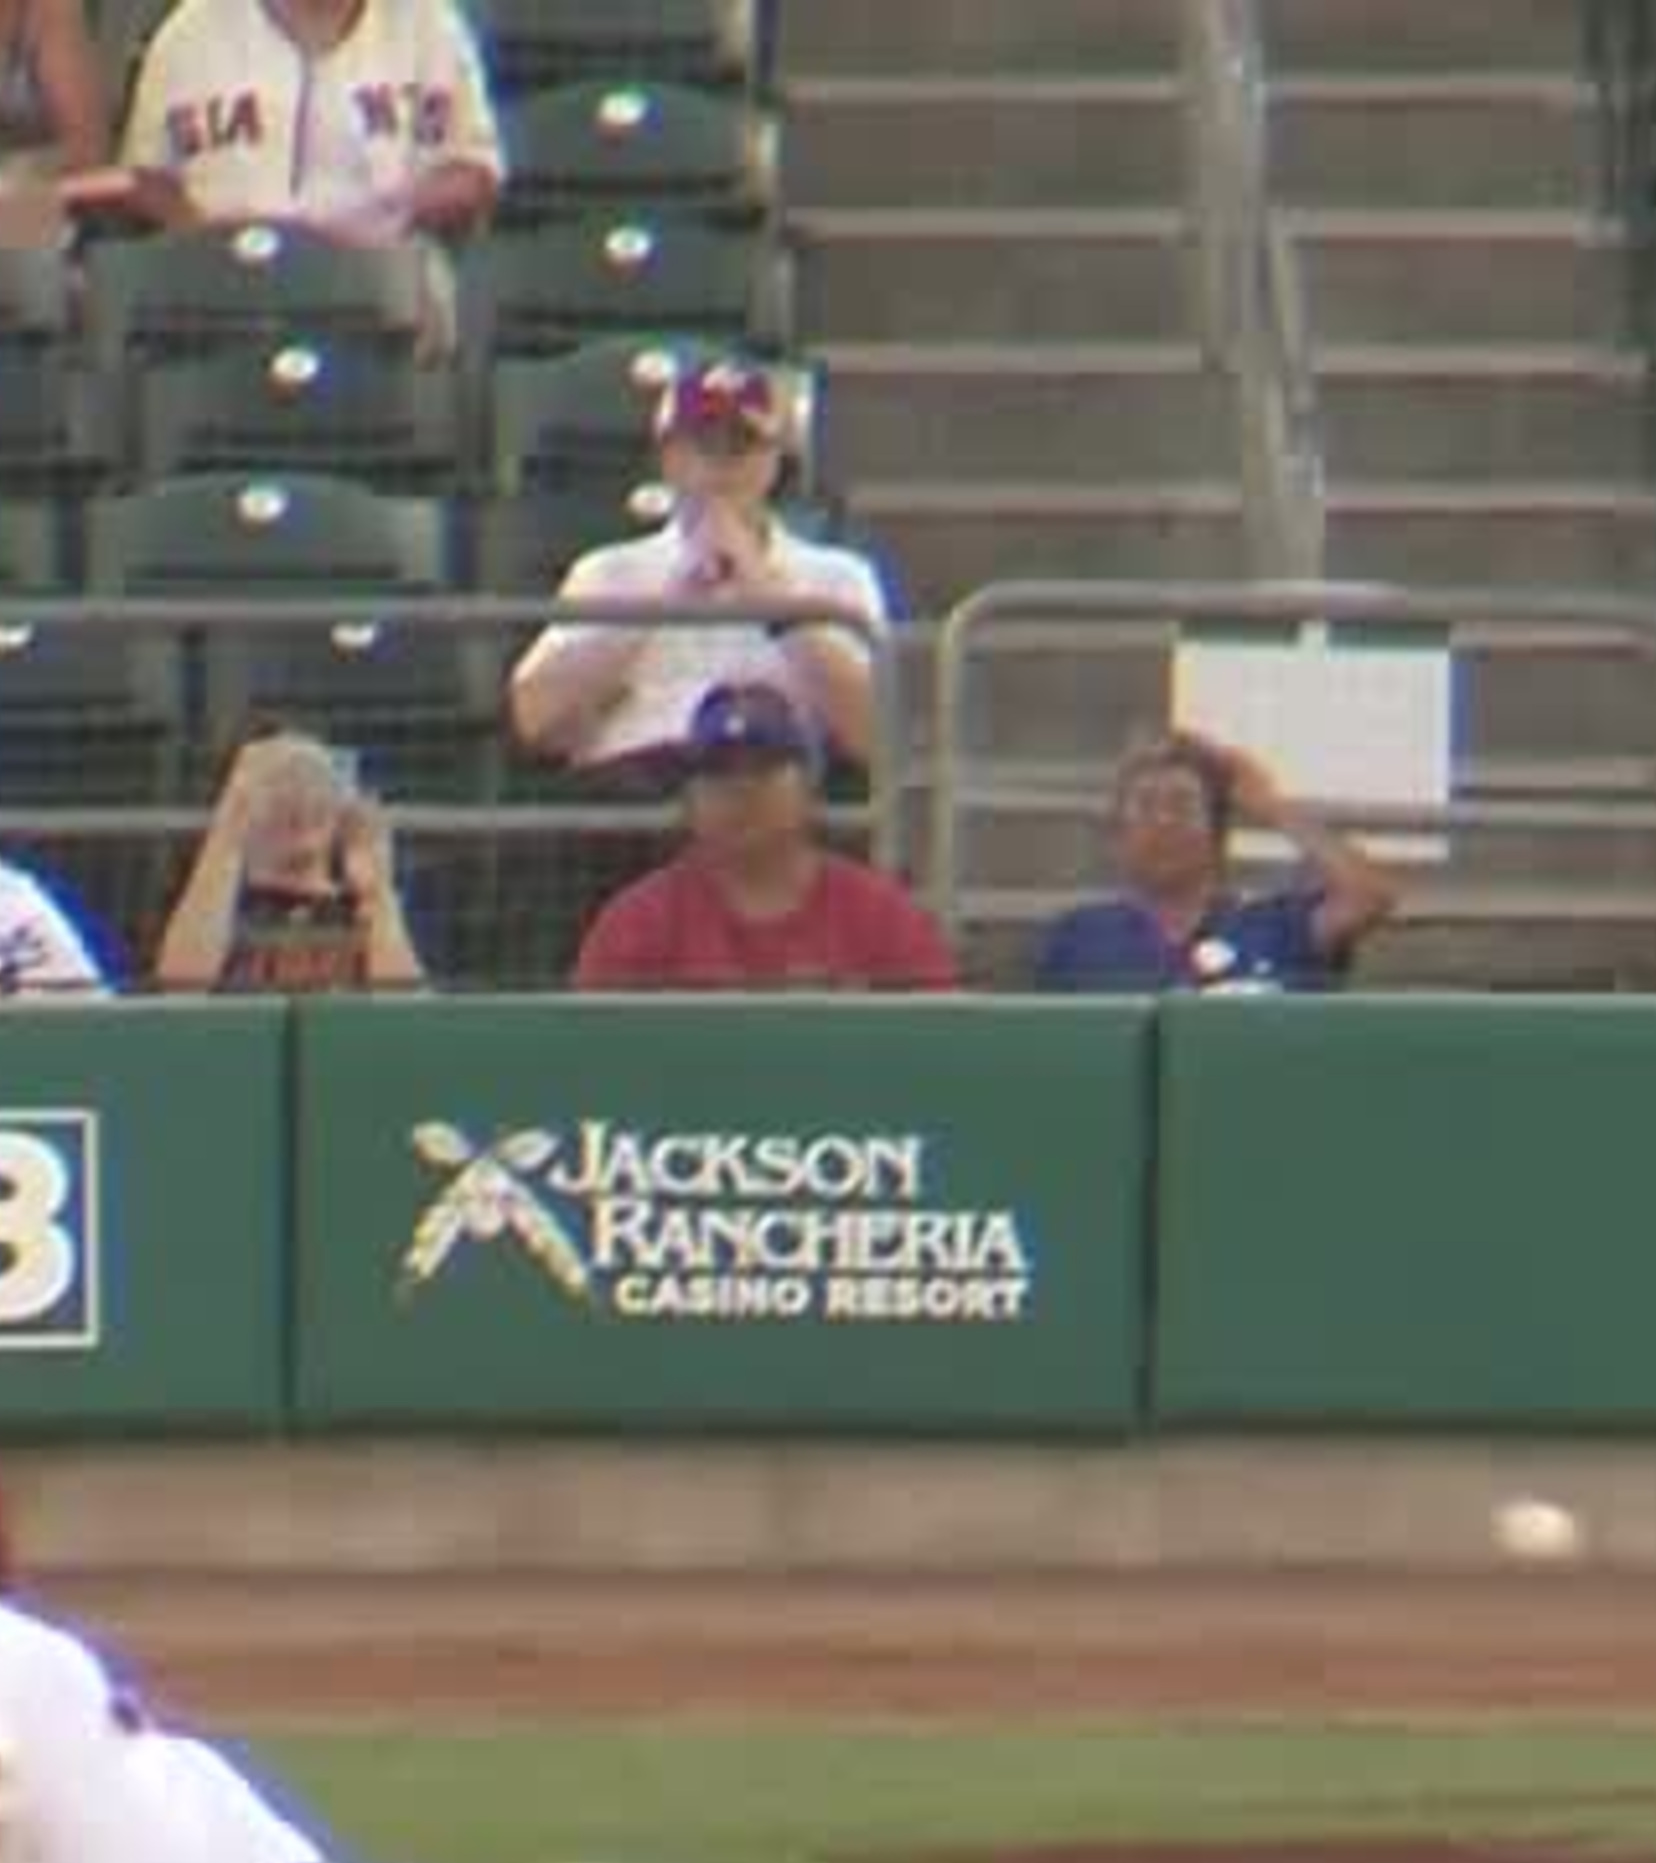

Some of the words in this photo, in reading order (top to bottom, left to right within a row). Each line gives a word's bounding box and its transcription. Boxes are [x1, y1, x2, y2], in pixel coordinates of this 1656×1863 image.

[549, 1120, 922, 1196] JACKSON
[613, 1280, 810, 1319] CASINO
[826, 1280, 1030, 1319] RESORT
